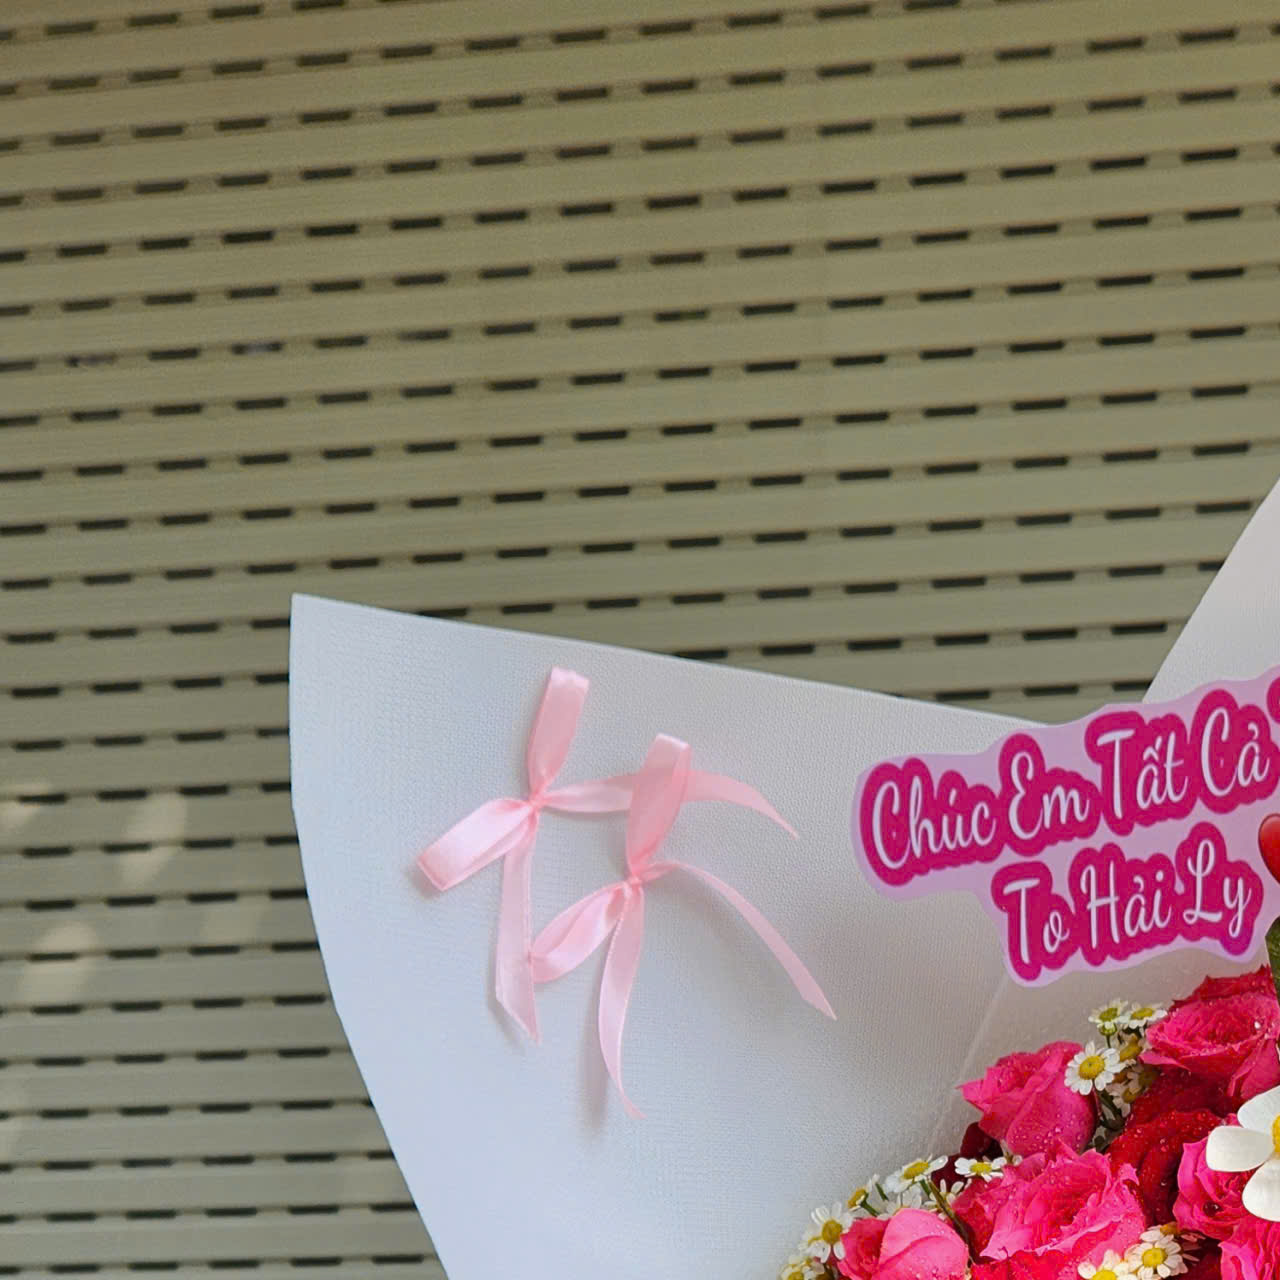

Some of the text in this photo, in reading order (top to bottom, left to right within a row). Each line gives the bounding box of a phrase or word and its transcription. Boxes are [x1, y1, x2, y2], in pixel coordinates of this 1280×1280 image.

[872, 775, 997, 869] Chúc
[1008, 751, 1090, 840] Em
[1096, 728, 1188, 820] Tất
[1200, 706, 1270, 797] Cả
[1003, 839, 1251, 965] To Hải Ly
